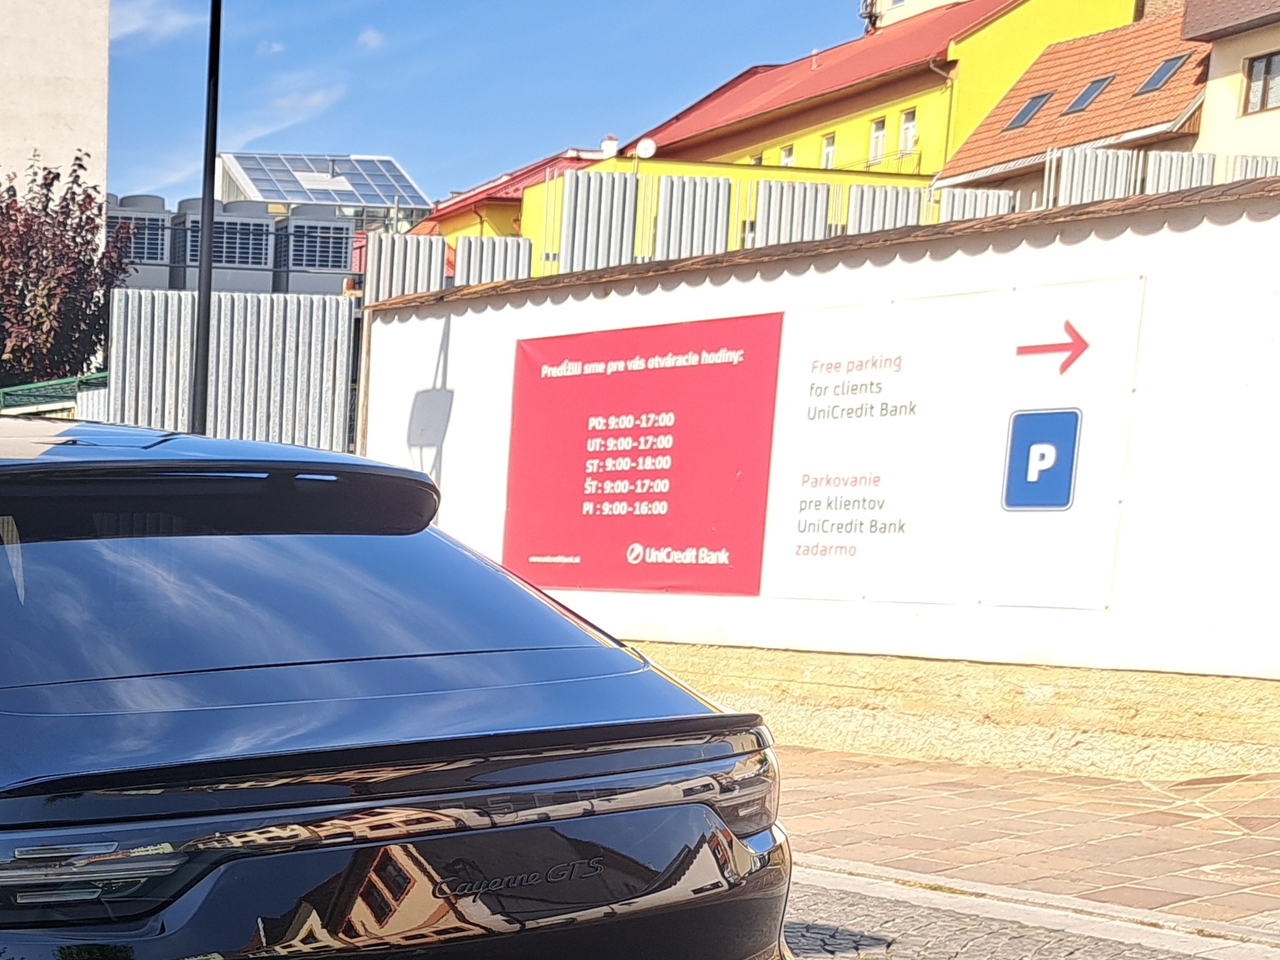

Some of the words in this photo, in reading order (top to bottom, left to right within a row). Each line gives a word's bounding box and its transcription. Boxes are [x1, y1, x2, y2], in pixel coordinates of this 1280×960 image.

[583, 362, 605, 374] sme
[606, 360, 625, 375] pre
[627, 355, 645, 370] vás
[647, 351, 699, 369] otváracie
[811, 359, 842, 374] Free
[846, 354, 902, 375] parking
[809, 382, 829, 397] for
[833, 380, 882, 396] clients
[807, 403, 875, 421] UniCredit
[880, 401, 917, 417] Bank
[588, 416, 606, 430] PO:
[586, 438, 605, 452] UT:
[585, 459, 603, 473] ST:
[1026, 443, 1057, 483] P
[801, 472, 881, 488] Parkovanie
[799, 499, 822, 514] pre
[826, 496, 885, 510] klientov
[797, 519, 864, 533] UniCredit
[869, 518, 906, 534] Bank
[645, 547, 697, 564] UniCredit
[698, 547, 729, 564] Bank
[795, 542, 857, 556] zadarmo
[432, 872, 542, 902] Cayenne
[546, 857, 604, 882] GTS
